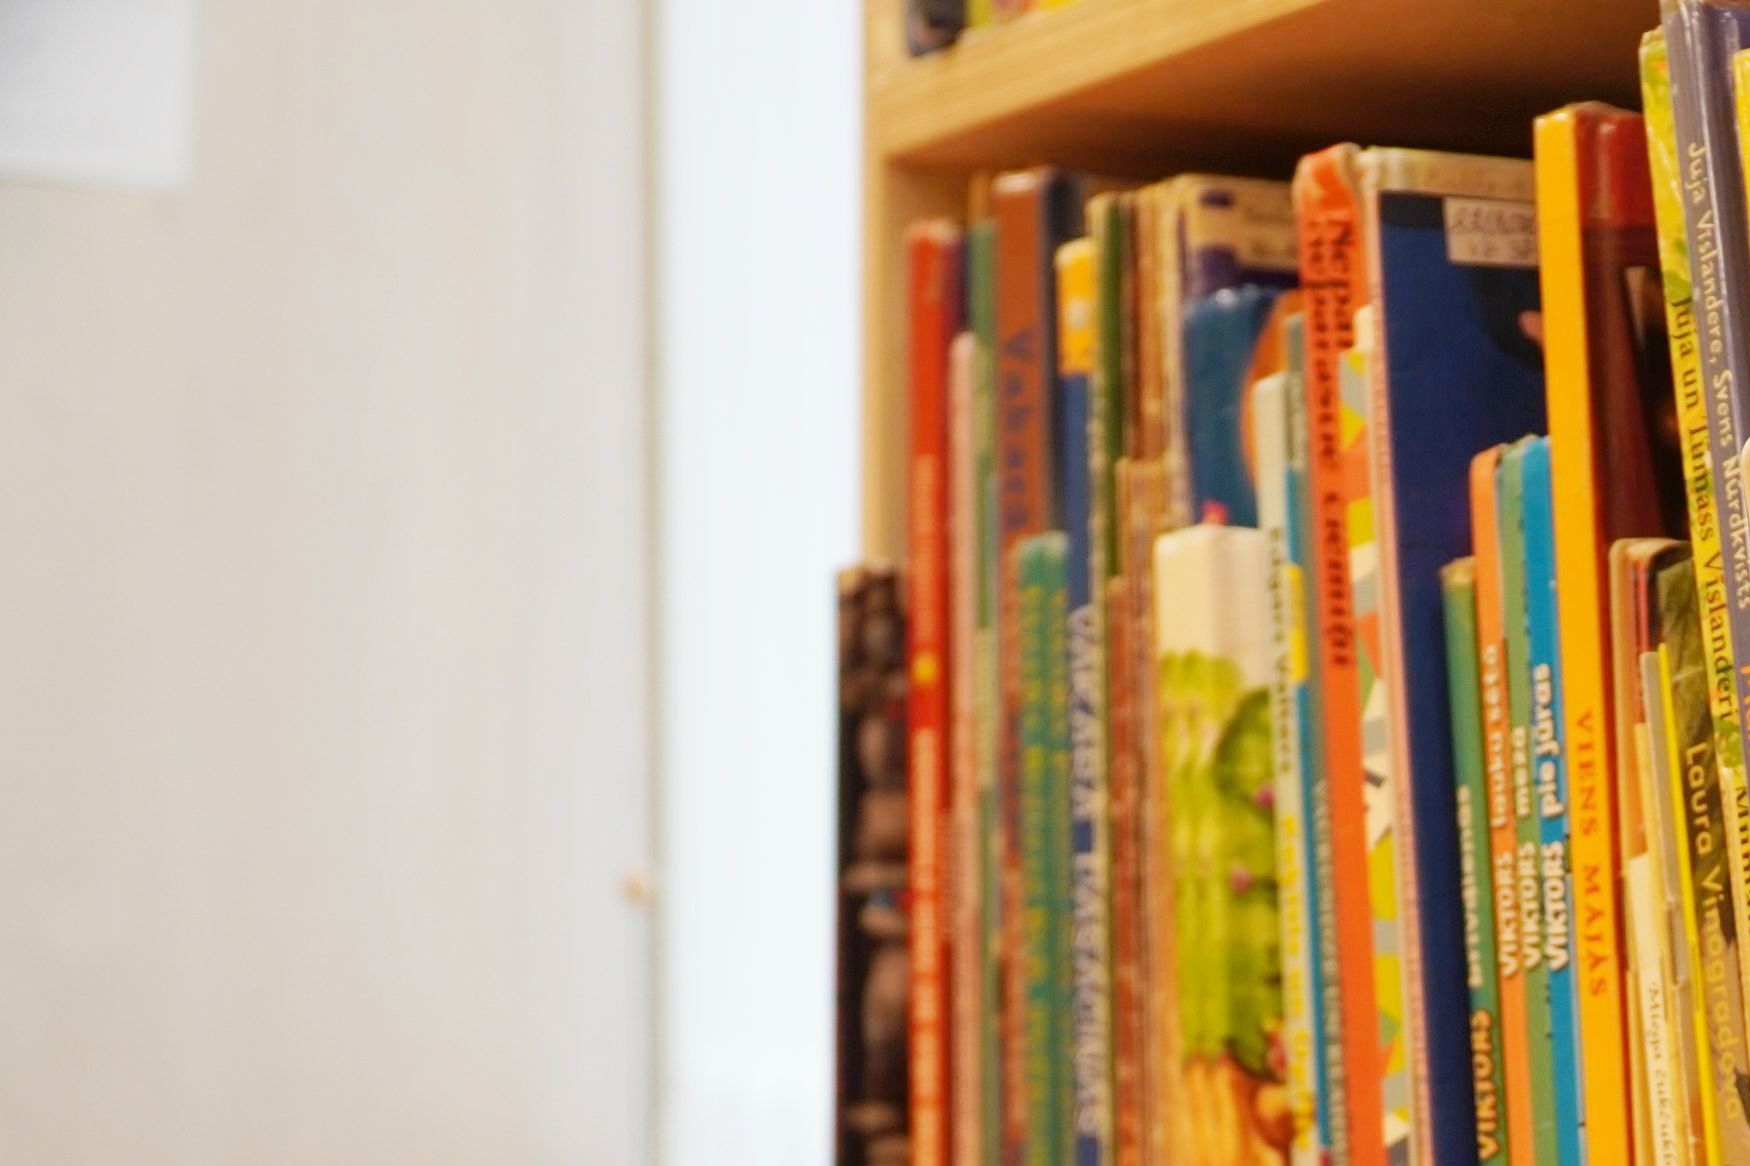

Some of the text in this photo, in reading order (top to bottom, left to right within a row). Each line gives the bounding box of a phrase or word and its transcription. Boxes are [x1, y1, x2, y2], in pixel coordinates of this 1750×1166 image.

[1669, 297, 1697, 358] Juja
[1685, 141, 1707, 205] Juja
[1712, 368, 1736, 448] Svens
[1682, 366, 1699, 410] un
[1536, 760, 1564, 818] pie
[1576, 708, 1599, 837] VIENS
[1494, 849, 1519, 978] VIKTORS
[1517, 841, 1543, 970] VIKTORS
[1542, 840, 1570, 971] VIKTORS
[1686, 741, 1743, 1121] Laura Vinogradova
[1471, 1009, 1499, 1161] VIKTORS
